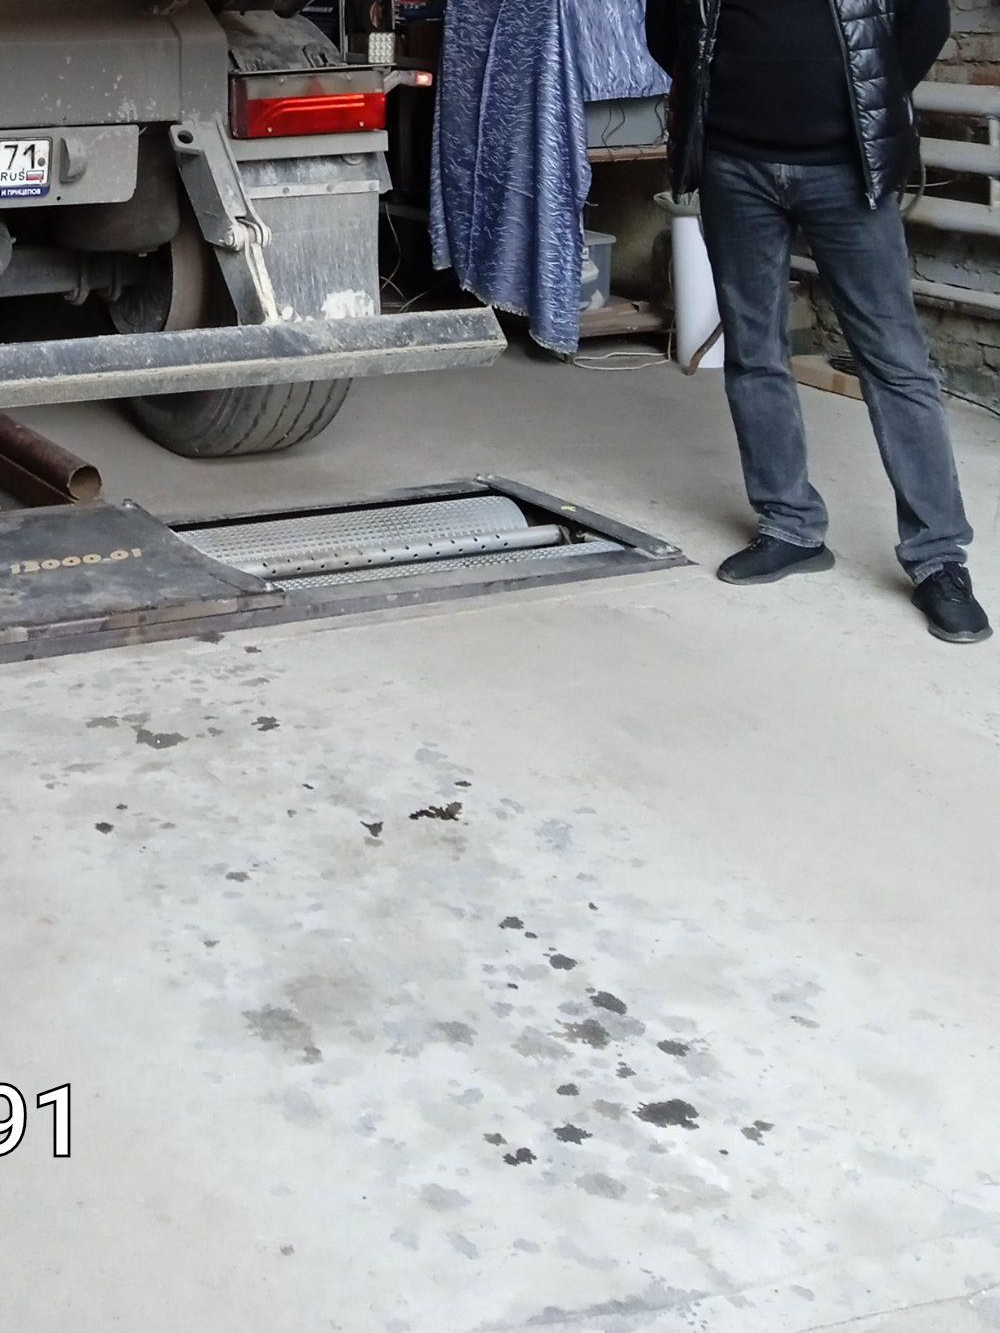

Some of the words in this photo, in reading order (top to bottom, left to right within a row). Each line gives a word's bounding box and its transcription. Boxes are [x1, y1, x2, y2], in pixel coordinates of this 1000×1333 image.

[3, 143, 36, 170] 71
[0, 170, 26, 183] RUS
[7, 187, 41, 197] ПРИЦЕПОВ
